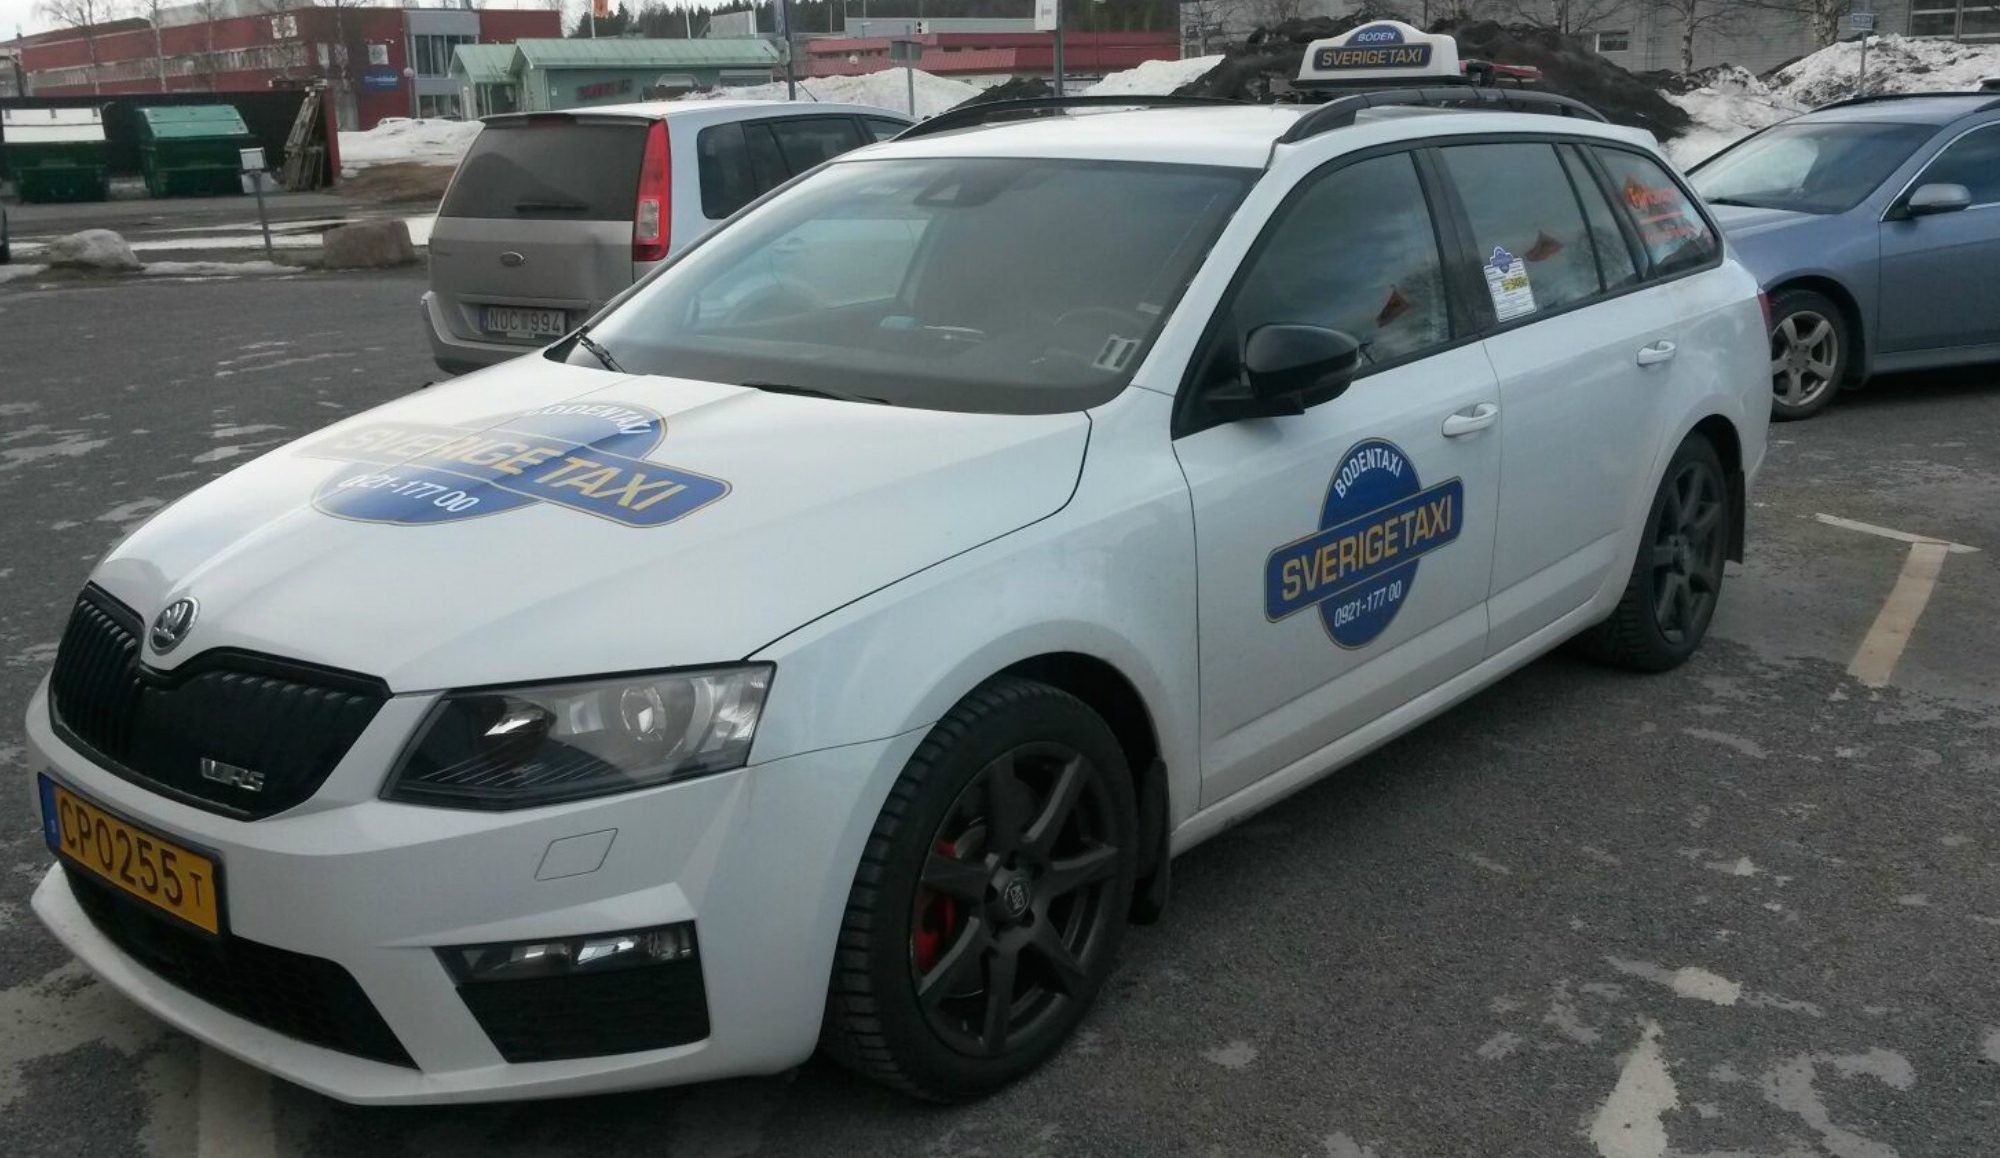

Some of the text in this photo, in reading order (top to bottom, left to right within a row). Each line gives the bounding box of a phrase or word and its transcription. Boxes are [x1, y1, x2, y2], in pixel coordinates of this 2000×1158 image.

[1357, 32, 1396, 42] BODEN
[530, 311, 562, 332] 994
[1333, 448, 1403, 498] BODENTAXI
[433, 490, 480, 513] 00
[1334, 580, 1403, 628] 0921-177 00
[189, 871, 202, 907] T
